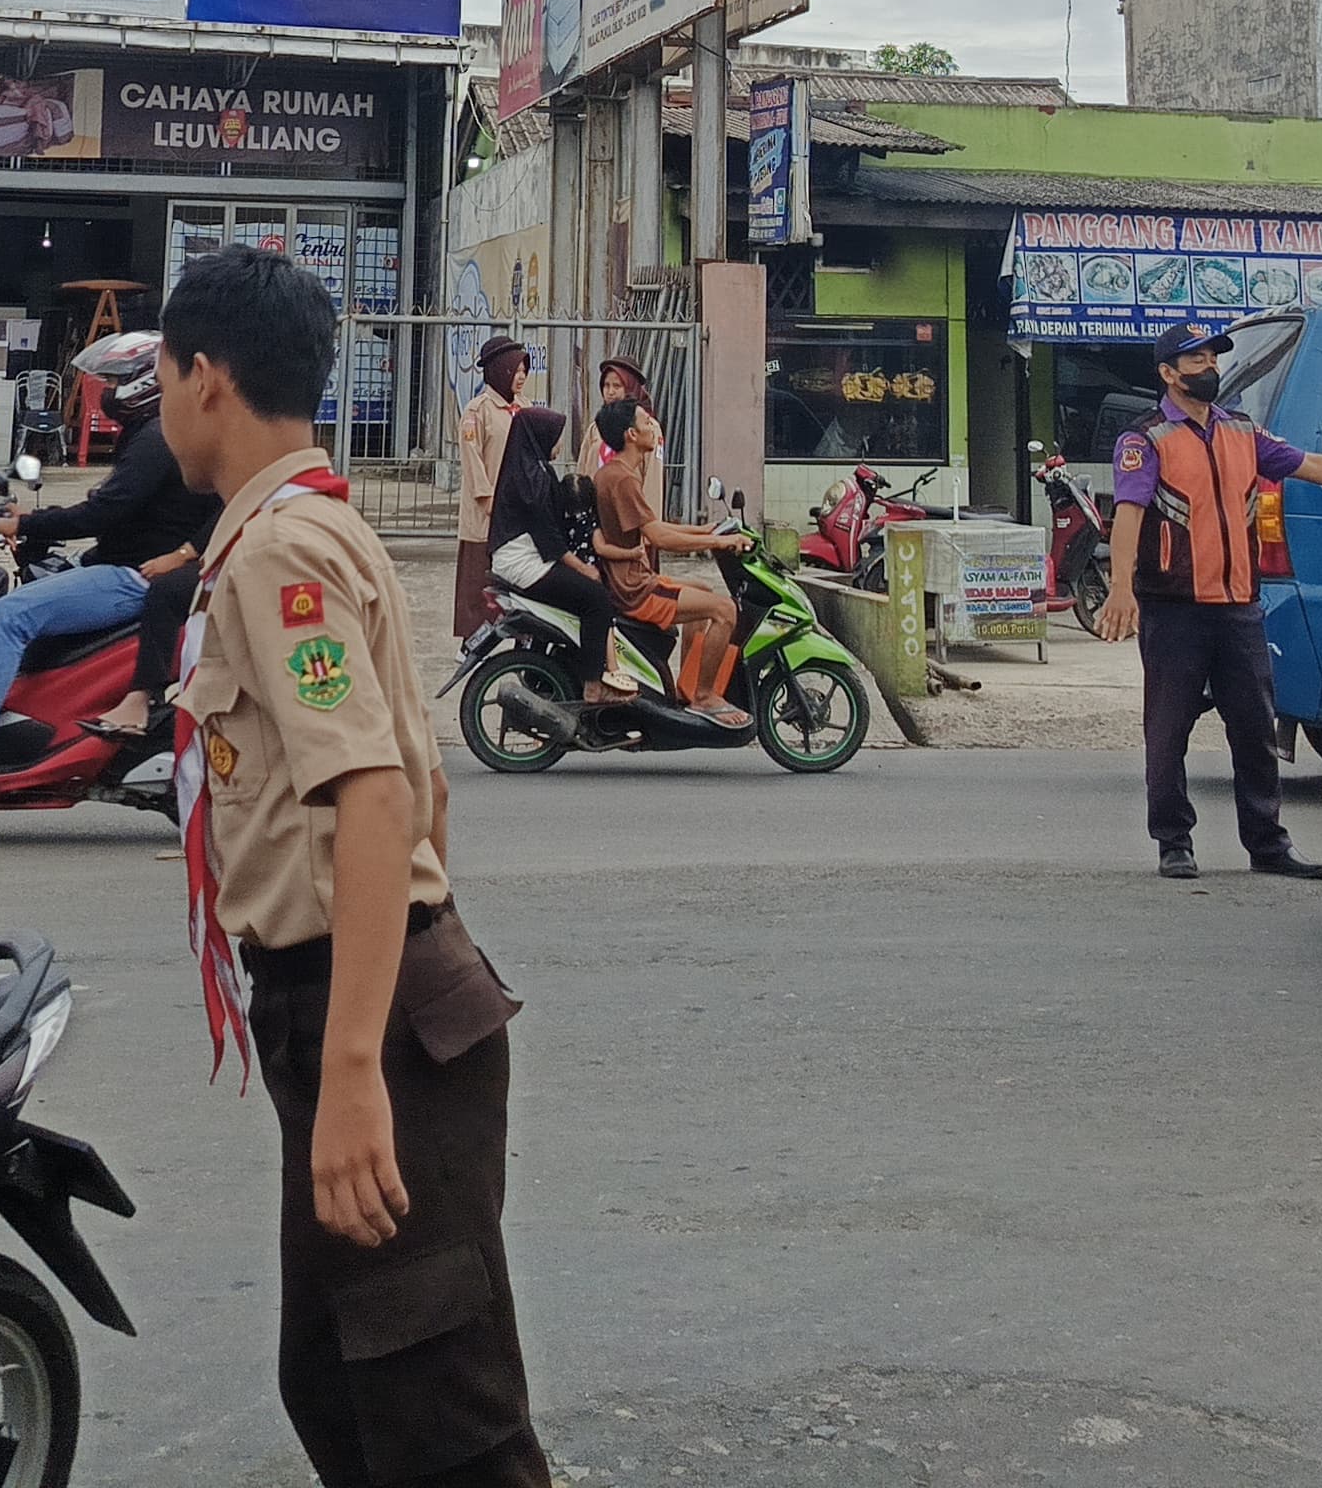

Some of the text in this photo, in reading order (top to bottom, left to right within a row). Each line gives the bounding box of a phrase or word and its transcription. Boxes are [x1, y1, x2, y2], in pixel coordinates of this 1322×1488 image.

[120, 83, 374, 118] CAHAYA RUMAH
[1023, 212, 1176, 250] PANGGANG
[1180, 217, 1257, 253] AYAM
[1040, 321, 1077, 336] DEPAN
[1079, 321, 1140, 337] TERMINAL
